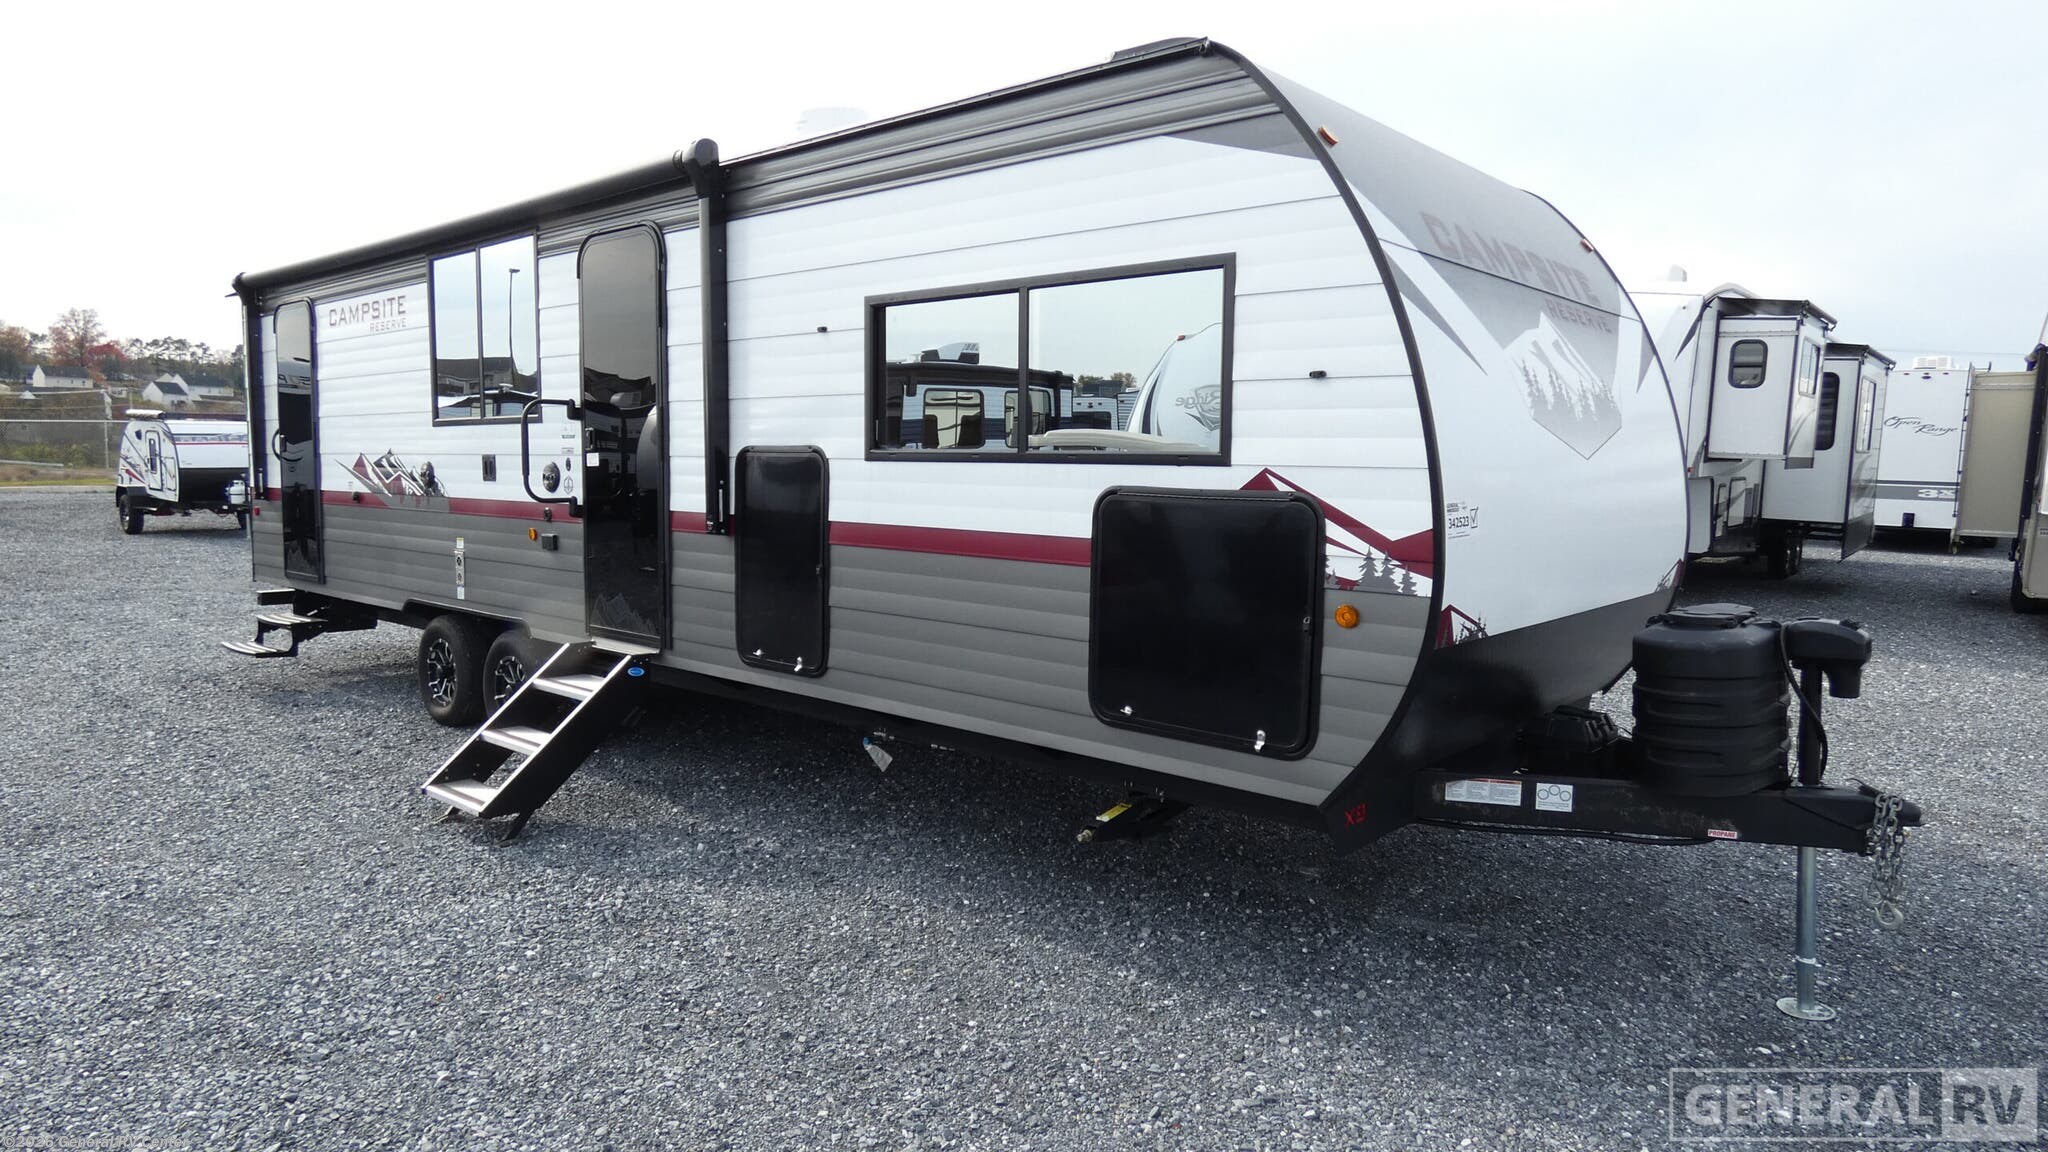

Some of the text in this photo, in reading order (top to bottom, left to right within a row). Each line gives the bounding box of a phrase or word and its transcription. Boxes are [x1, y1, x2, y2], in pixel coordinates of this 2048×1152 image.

[1419, 211, 1601, 307] CAMPSITE
[328, 295, 407, 327] CAMPSITE
[1544, 297, 1613, 334] RESERVE
[369, 317, 407, 333] RESERVE
[1884, 416, 1922, 429] Open
[1912, 423, 1958, 436] Range
[1449, 516, 1469, 529] 342523
[1708, 830, 1735, 838] PROPANE
